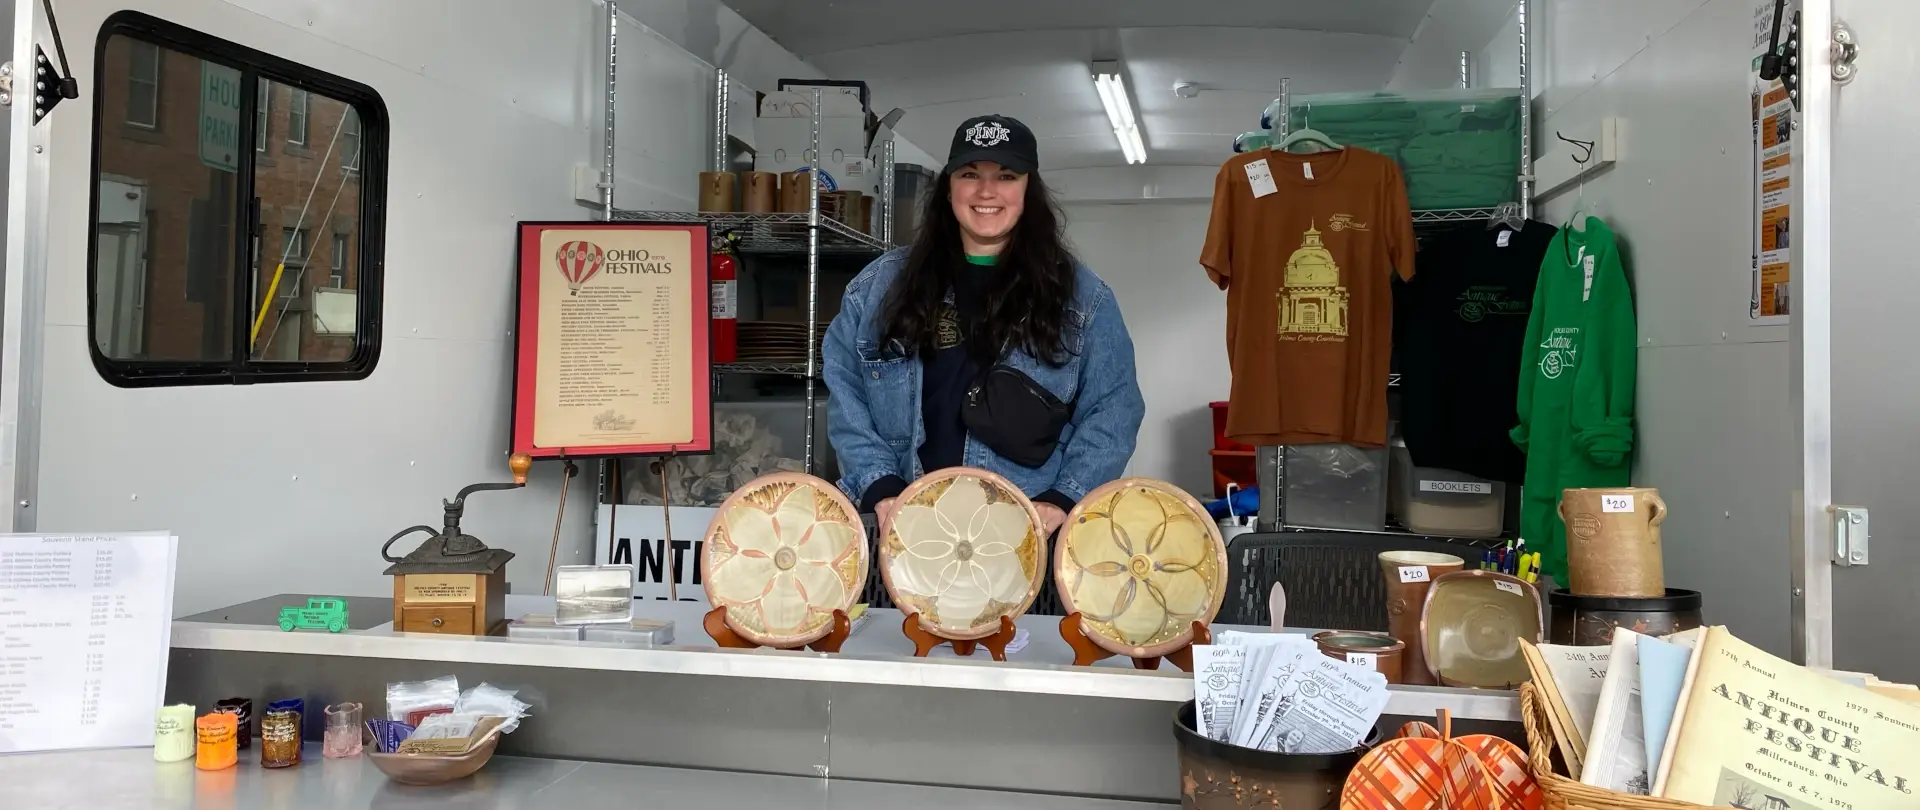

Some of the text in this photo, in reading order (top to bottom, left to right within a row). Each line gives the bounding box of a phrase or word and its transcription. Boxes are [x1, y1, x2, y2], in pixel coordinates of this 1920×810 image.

[965, 126, 1010, 142] PINK
[606, 249, 649, 262] OHIO
[605, 262, 672, 275] FESTIVALS
[1431, 482, 1481, 492] BOOKLETS
[1606, 498, 1627, 509] $20
[1403, 570, 1423, 579] $20
[1212, 648, 1230, 657] 60th
[1351, 657, 1367, 666] $15
[1564, 652, 1588, 664] 24th
[1720, 648, 1776, 680] 17th Annual
[1301, 669, 1340, 692] Antique
[1320, 660, 1340, 673] 60th
[1340, 672, 1372, 693] Annual
[1300, 706, 1321, 721] October
[1324, 689, 1369, 715] Festival
[1767, 689, 1860, 734] Holmes County
[1301, 698, 1318, 712] Friday
[1319, 709, 1340, 724] through
[1341, 721, 1360, 736] Sunday
[1711, 682, 1862, 754] ANTIQUE
[1845, 701, 1920, 732] 1979 Souvenir
[1743, 717, 1912, 795] FESTIVAL
[1756, 747, 1848, 787] Millersburg, Ohio
[1745, 762, 1782, 783] October
[1798, 785, 1809, 795] &
[1829, 797, 1853, 810] 1979
